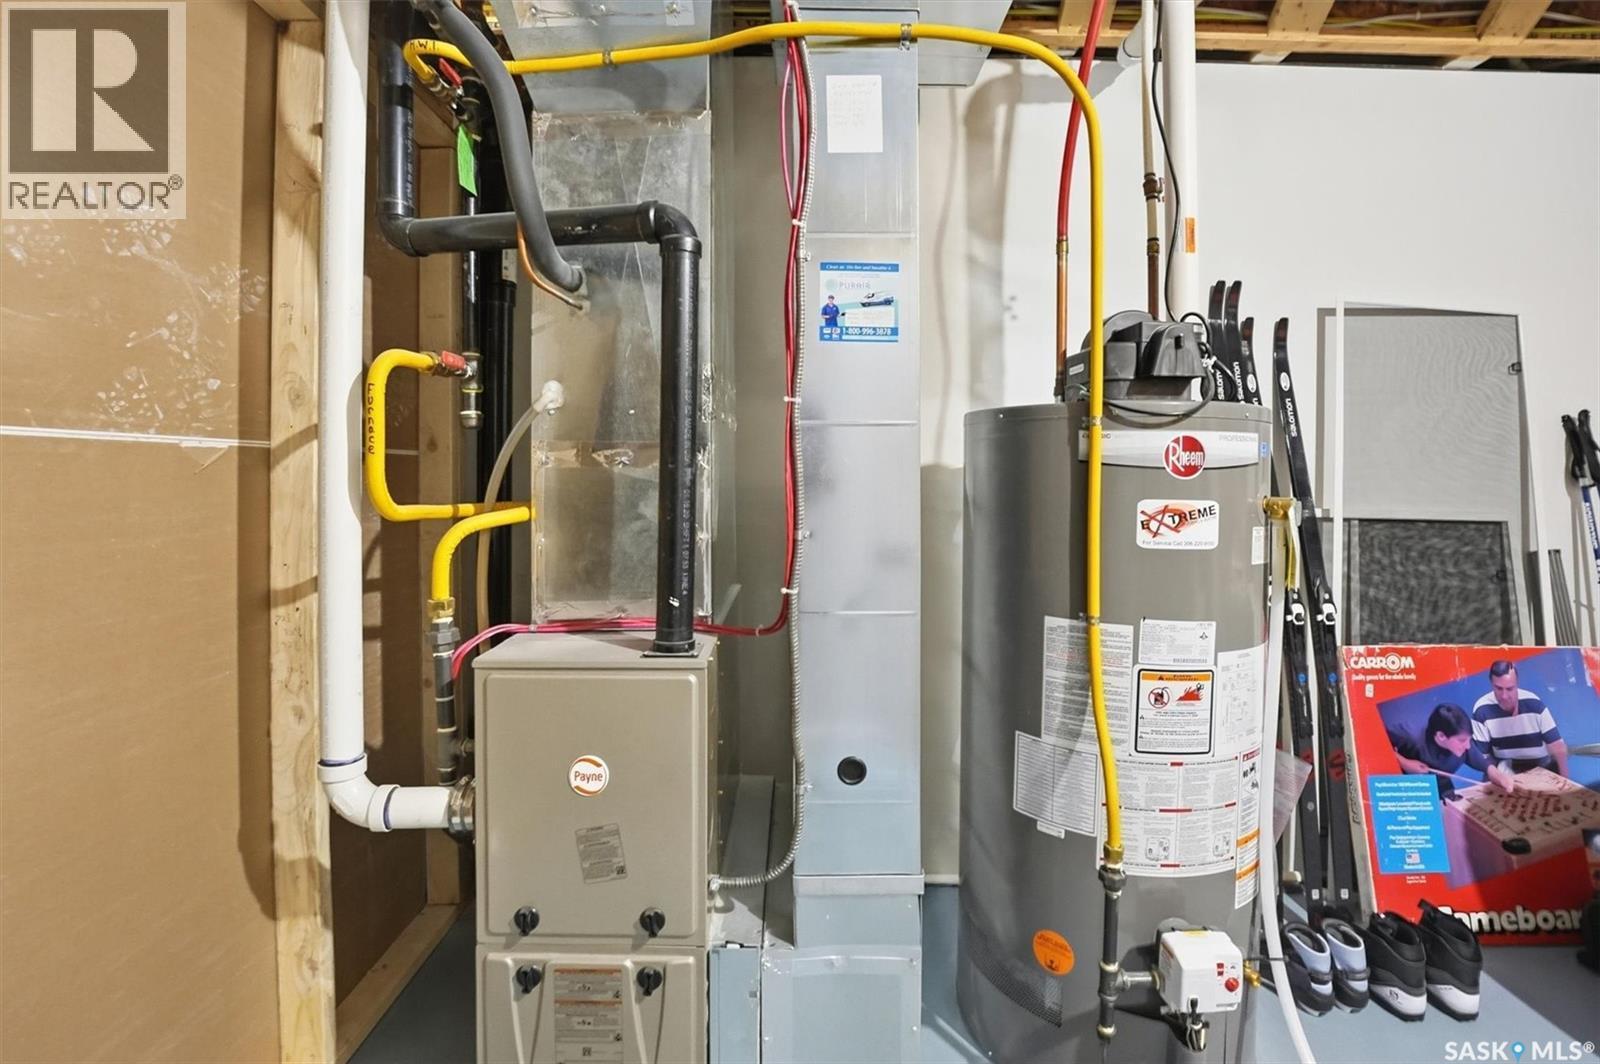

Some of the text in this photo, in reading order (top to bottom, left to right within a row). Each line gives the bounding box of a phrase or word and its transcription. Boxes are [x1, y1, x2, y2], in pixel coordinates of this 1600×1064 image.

[1168, 436, 1204, 472] Rheem
[1350, 653, 1416, 671] CARROM
[574, 770, 603, 784] Payne
